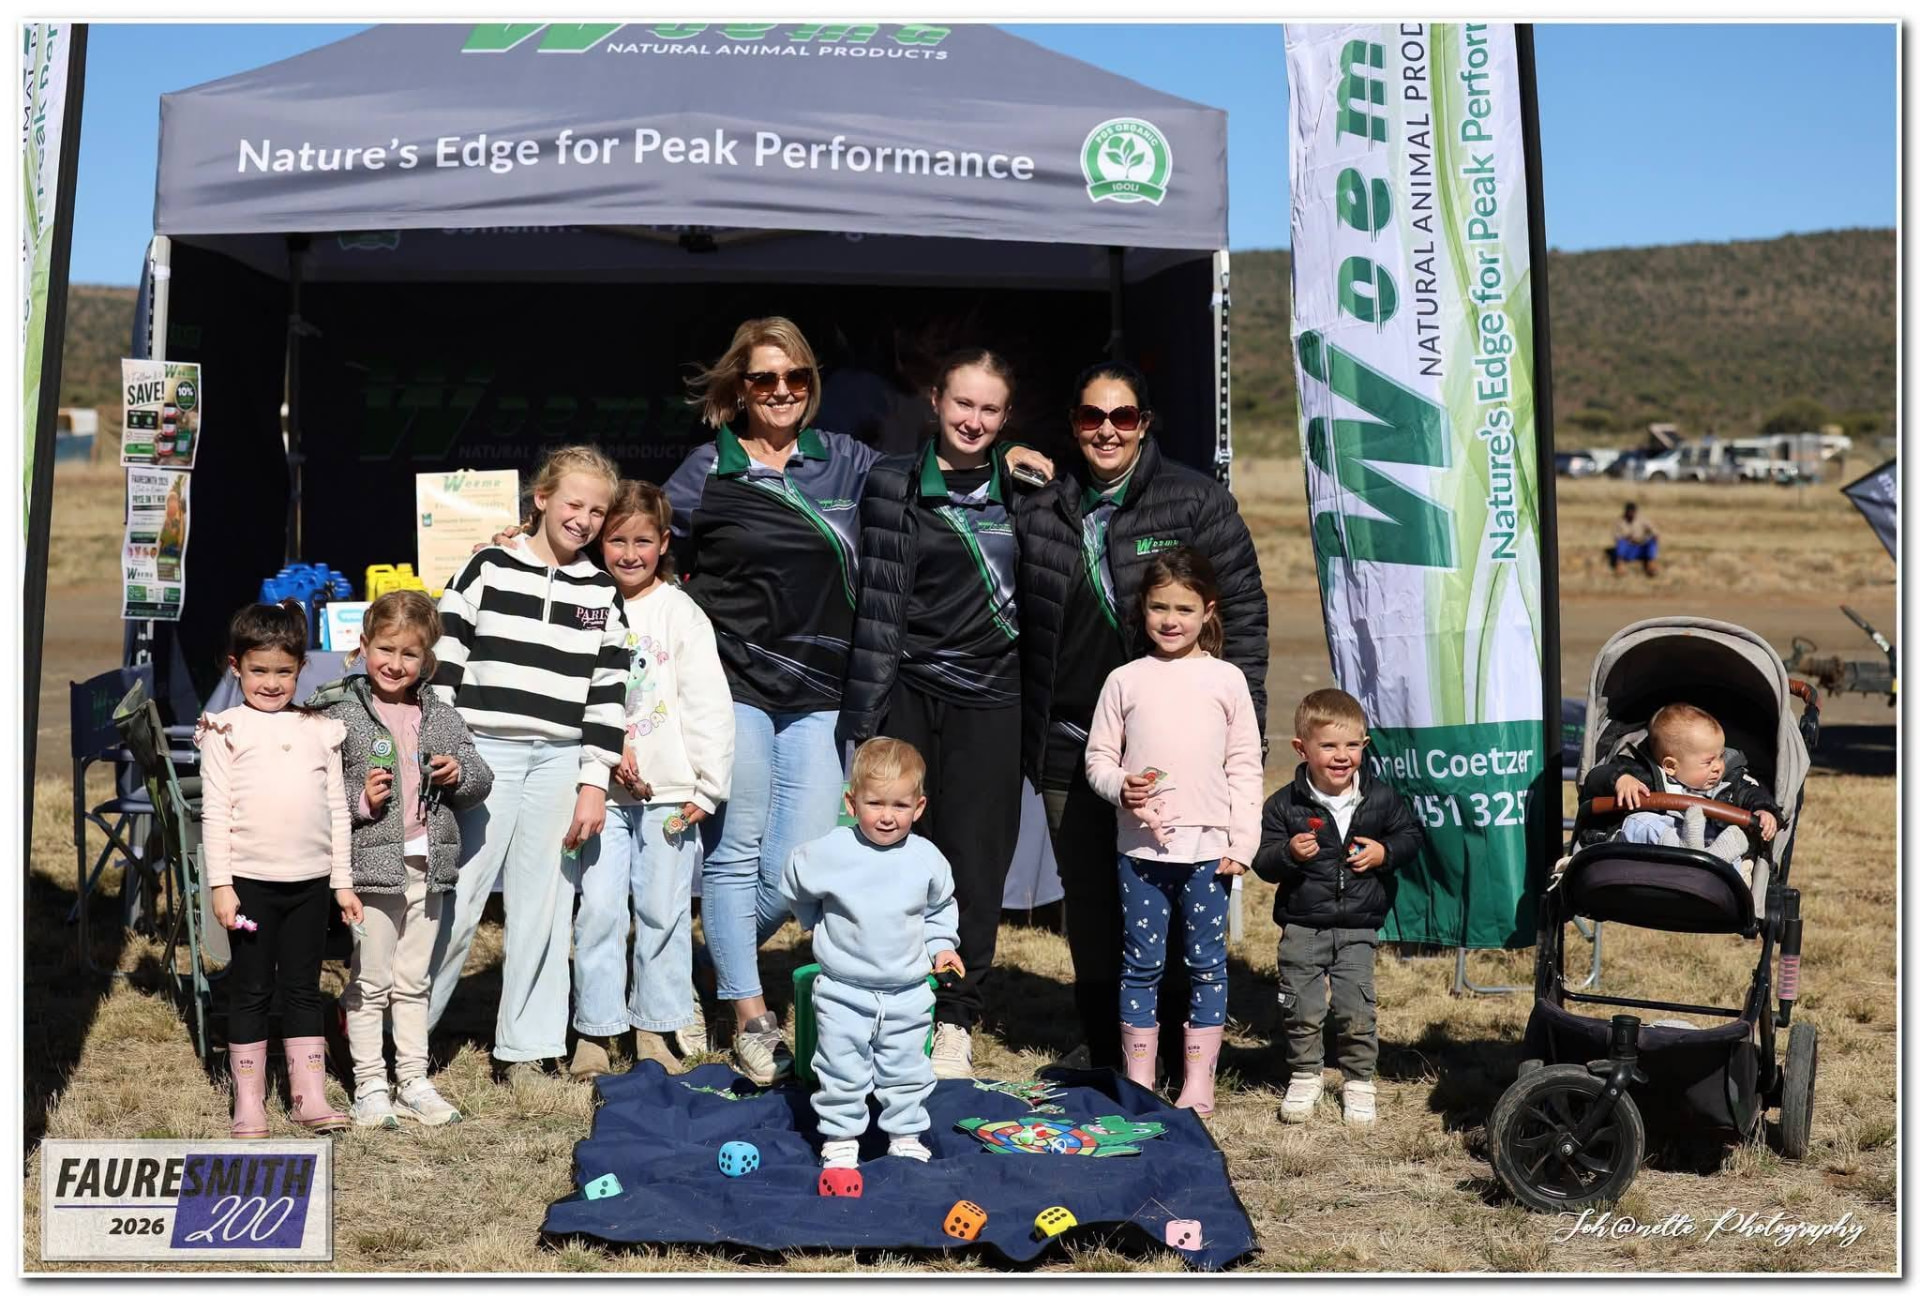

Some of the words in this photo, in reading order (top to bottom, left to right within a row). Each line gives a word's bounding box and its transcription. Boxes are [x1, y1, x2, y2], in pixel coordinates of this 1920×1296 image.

[607, 43, 710, 55] NATURAL
[716, 45, 811, 57] ANIMAL
[818, 46, 948, 60] PRODUCTS
[1115, 123, 1159, 147] ORGANIC
[237, 138, 419, 172] Nature’s
[436, 134, 539, 173] Edge
[555, 129, 619, 165] for
[634, 128, 738, 165] Peak
[755, 131, 1035, 181] Performance
[1112, 182, 1140, 193] IGOLI
[1406, 113, 1433, 233] ANIMAL
[1463, 152, 1498, 241] Peak
[1472, 251, 1502, 304] for
[1413, 241, 1443, 377] NATURAL
[1474, 313, 1513, 401] Edge
[128, 381, 165, 405] SAVE!
[178, 386, 195, 397] 10%
[457, 444, 530, 459] NATURAL
[606, 443, 690, 460] PRODUCT
[1480, 410, 1517, 559] Nature's
[575, 607, 610, 621] PARIS
[1426, 747, 1533, 779] Coetzer
